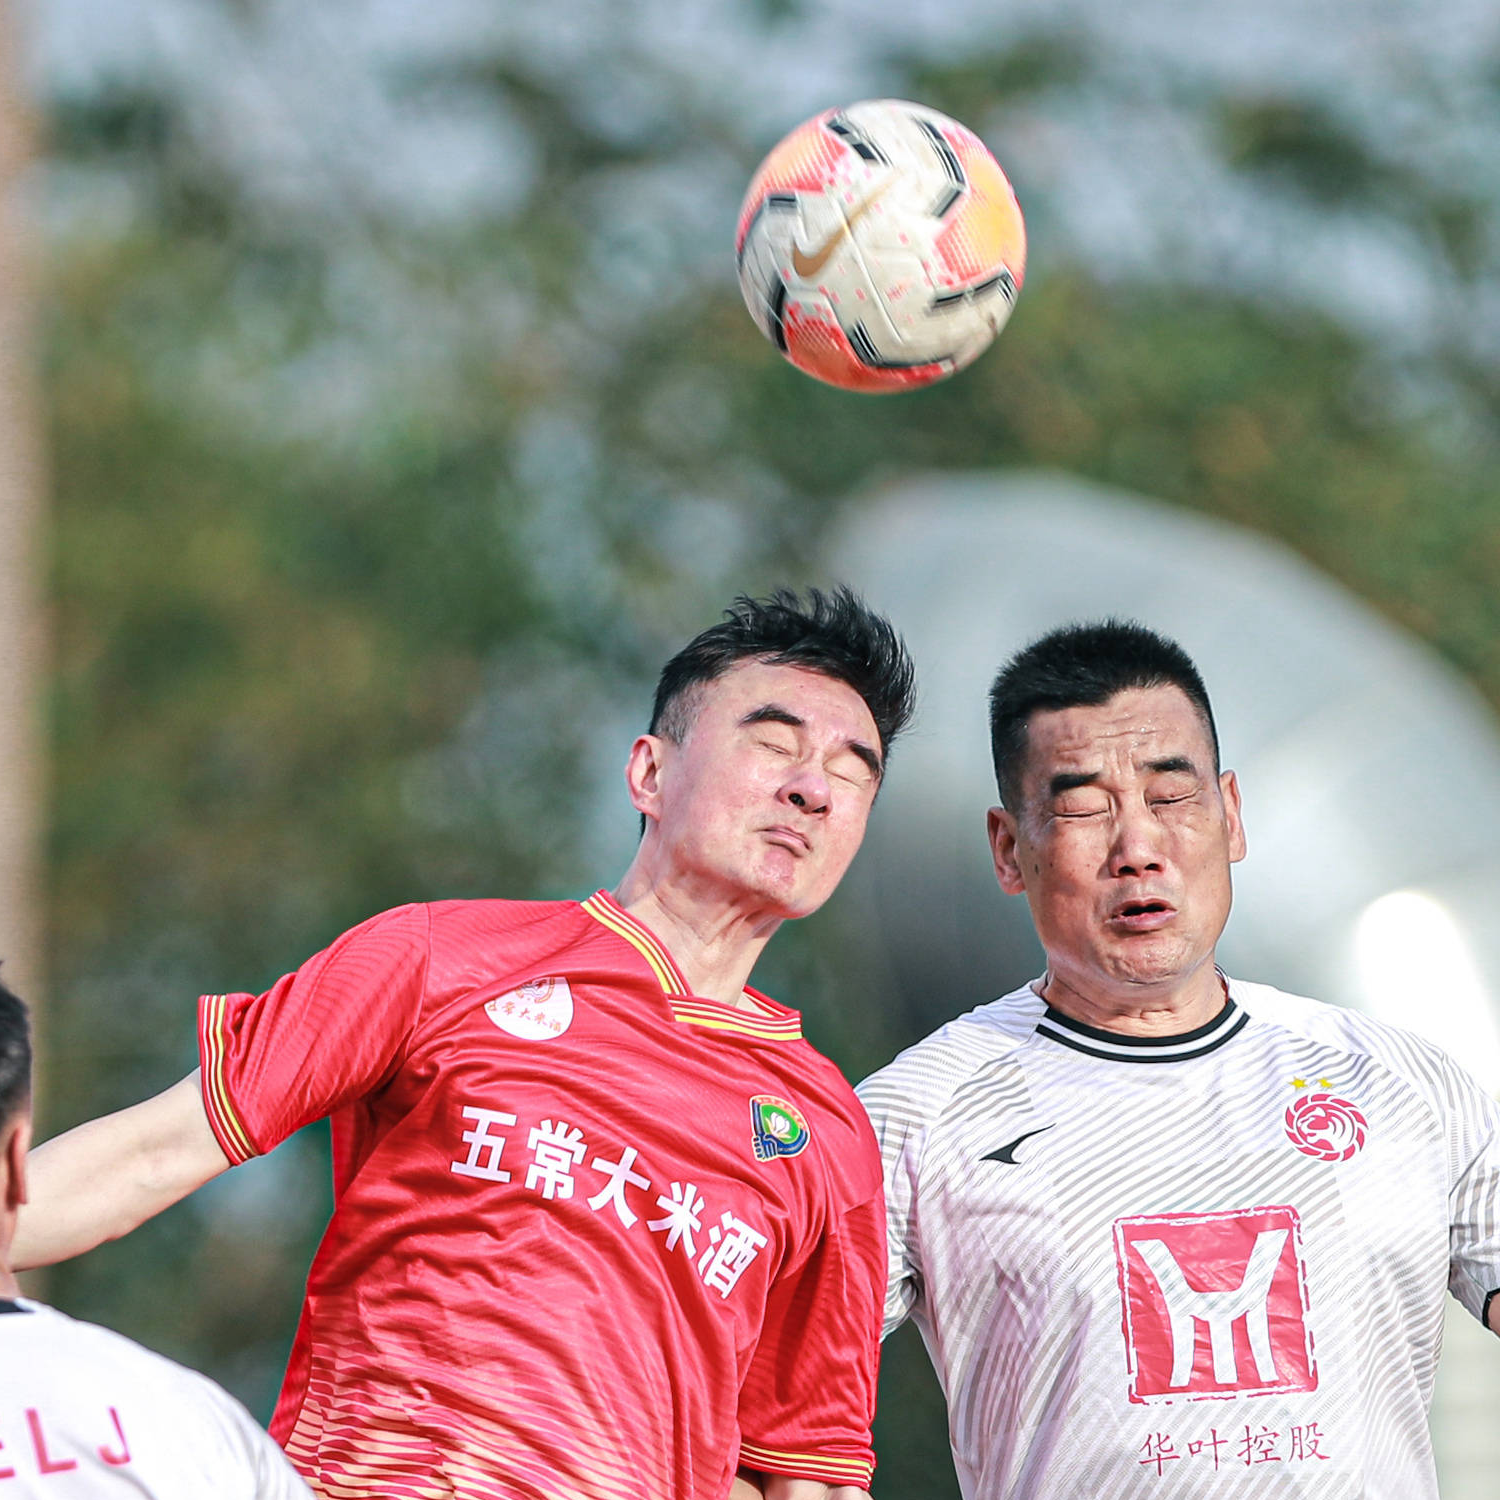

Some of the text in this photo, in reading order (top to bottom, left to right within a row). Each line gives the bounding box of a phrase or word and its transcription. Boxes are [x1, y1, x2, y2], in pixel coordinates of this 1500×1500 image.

[451, 1105, 768, 1300] 五常大米酒
[1138, 1422, 1331, 1477] 华叶控股
